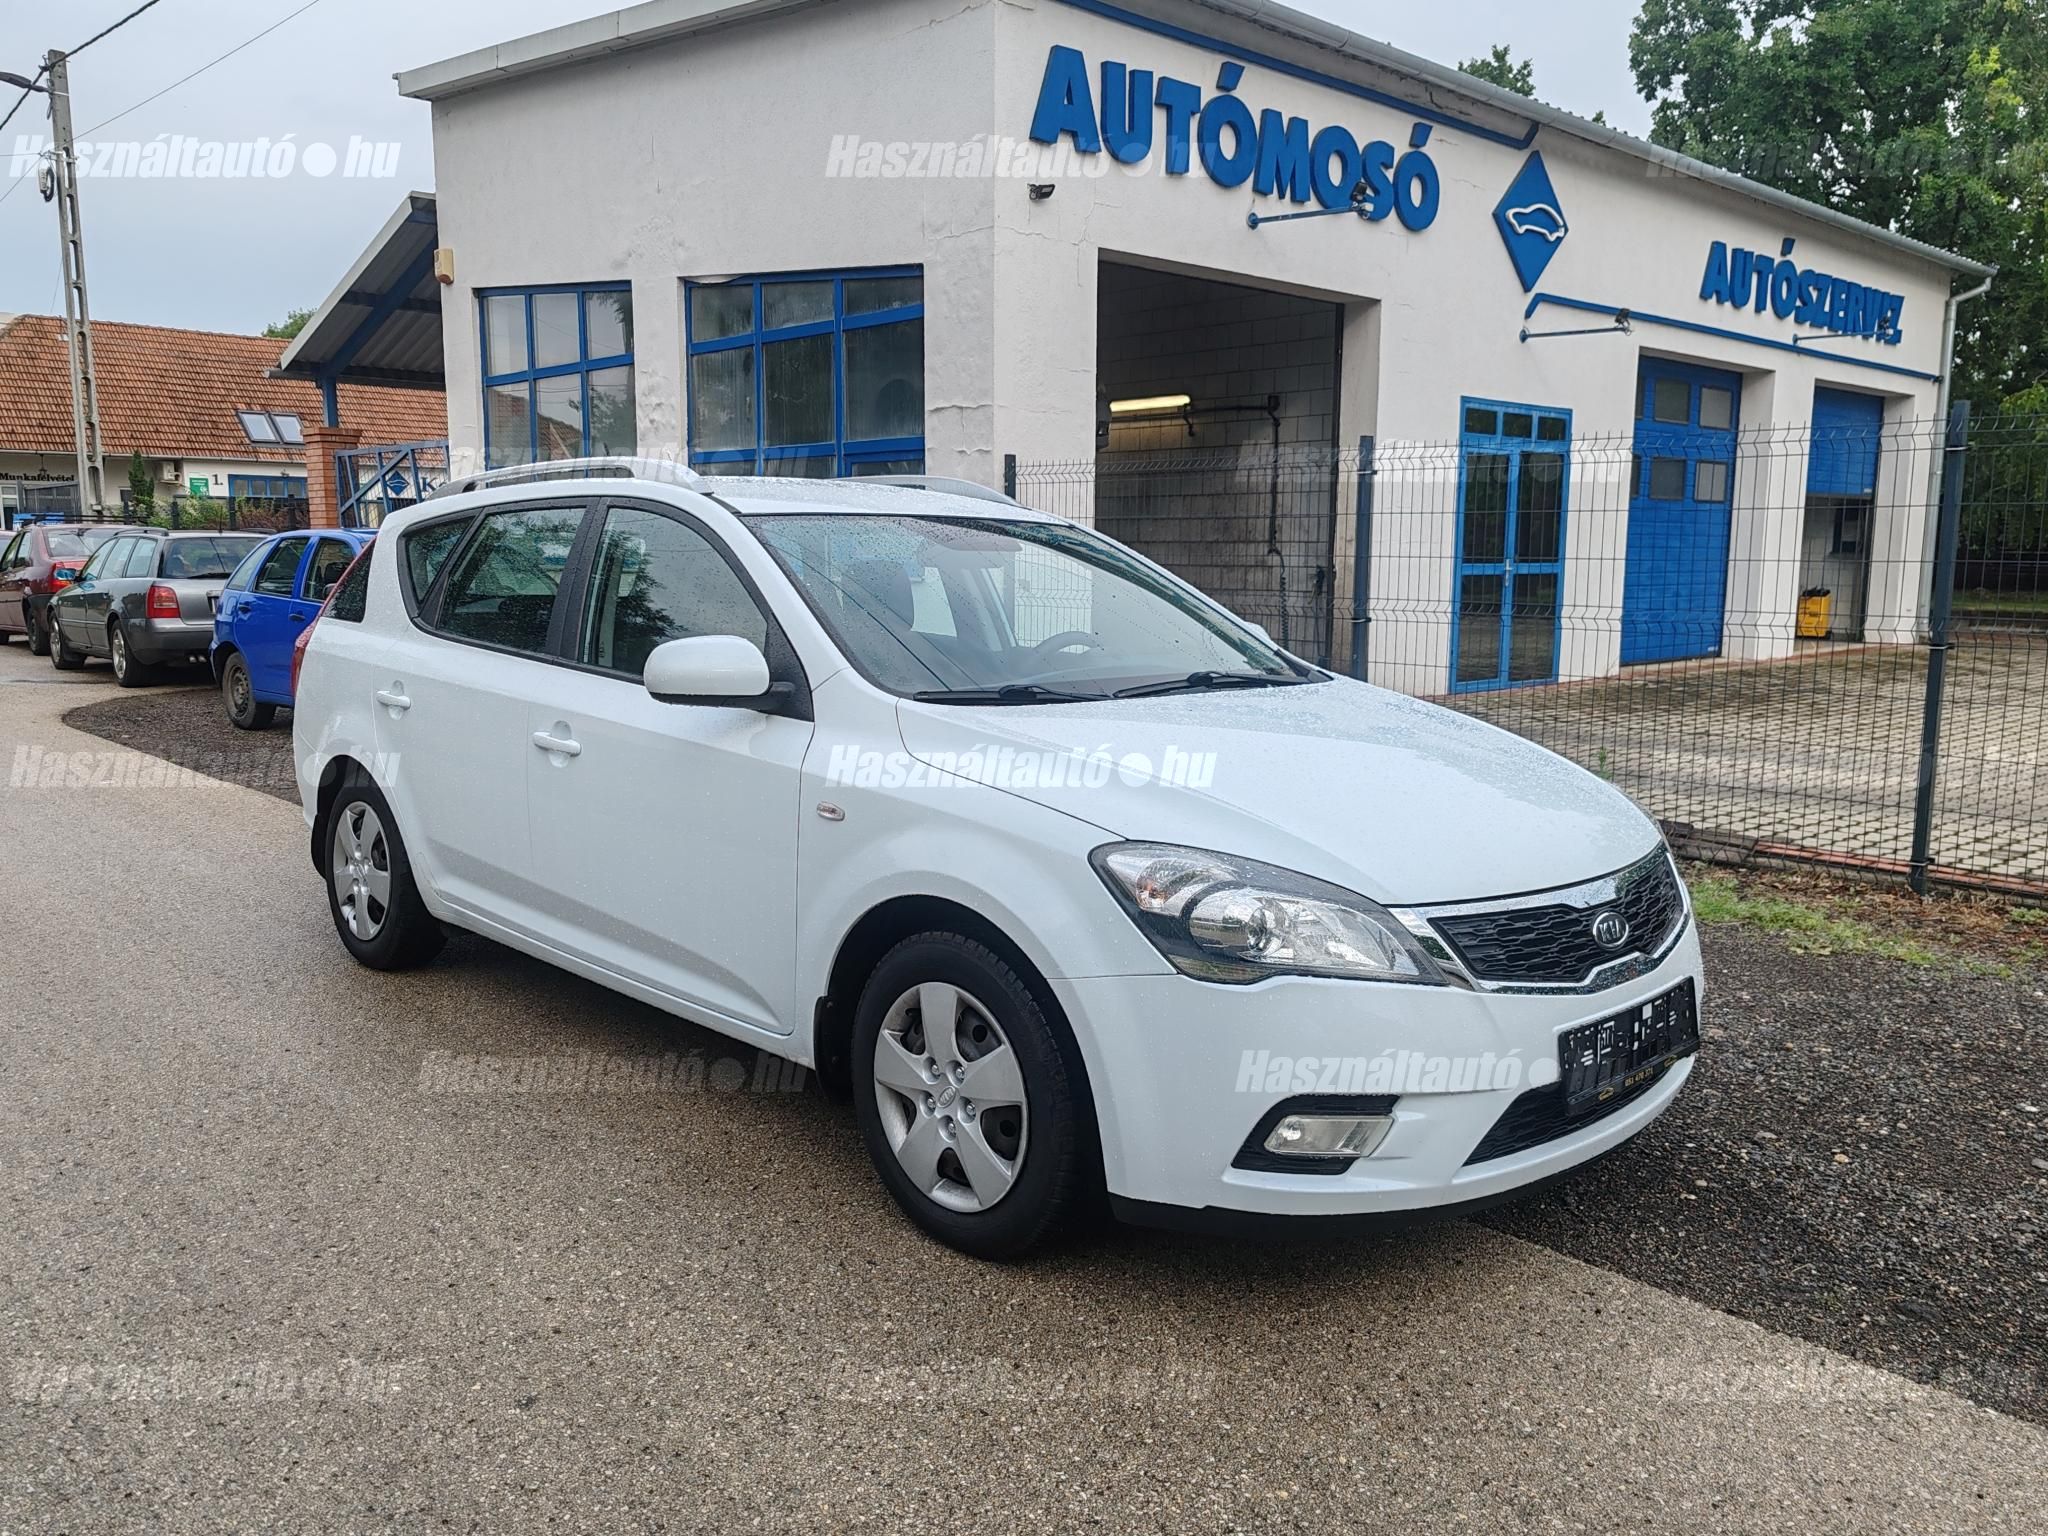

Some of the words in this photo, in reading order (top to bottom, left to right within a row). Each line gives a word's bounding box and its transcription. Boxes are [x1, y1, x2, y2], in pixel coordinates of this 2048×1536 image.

[1029, 45, 1440, 232] AUTÓMOSÓ
[1699, 238, 1905, 346] AUTÓSZERVIZ
[0, 472, 75, 482] Munkafélvétel
[1598, 918, 1621, 942] KIA
